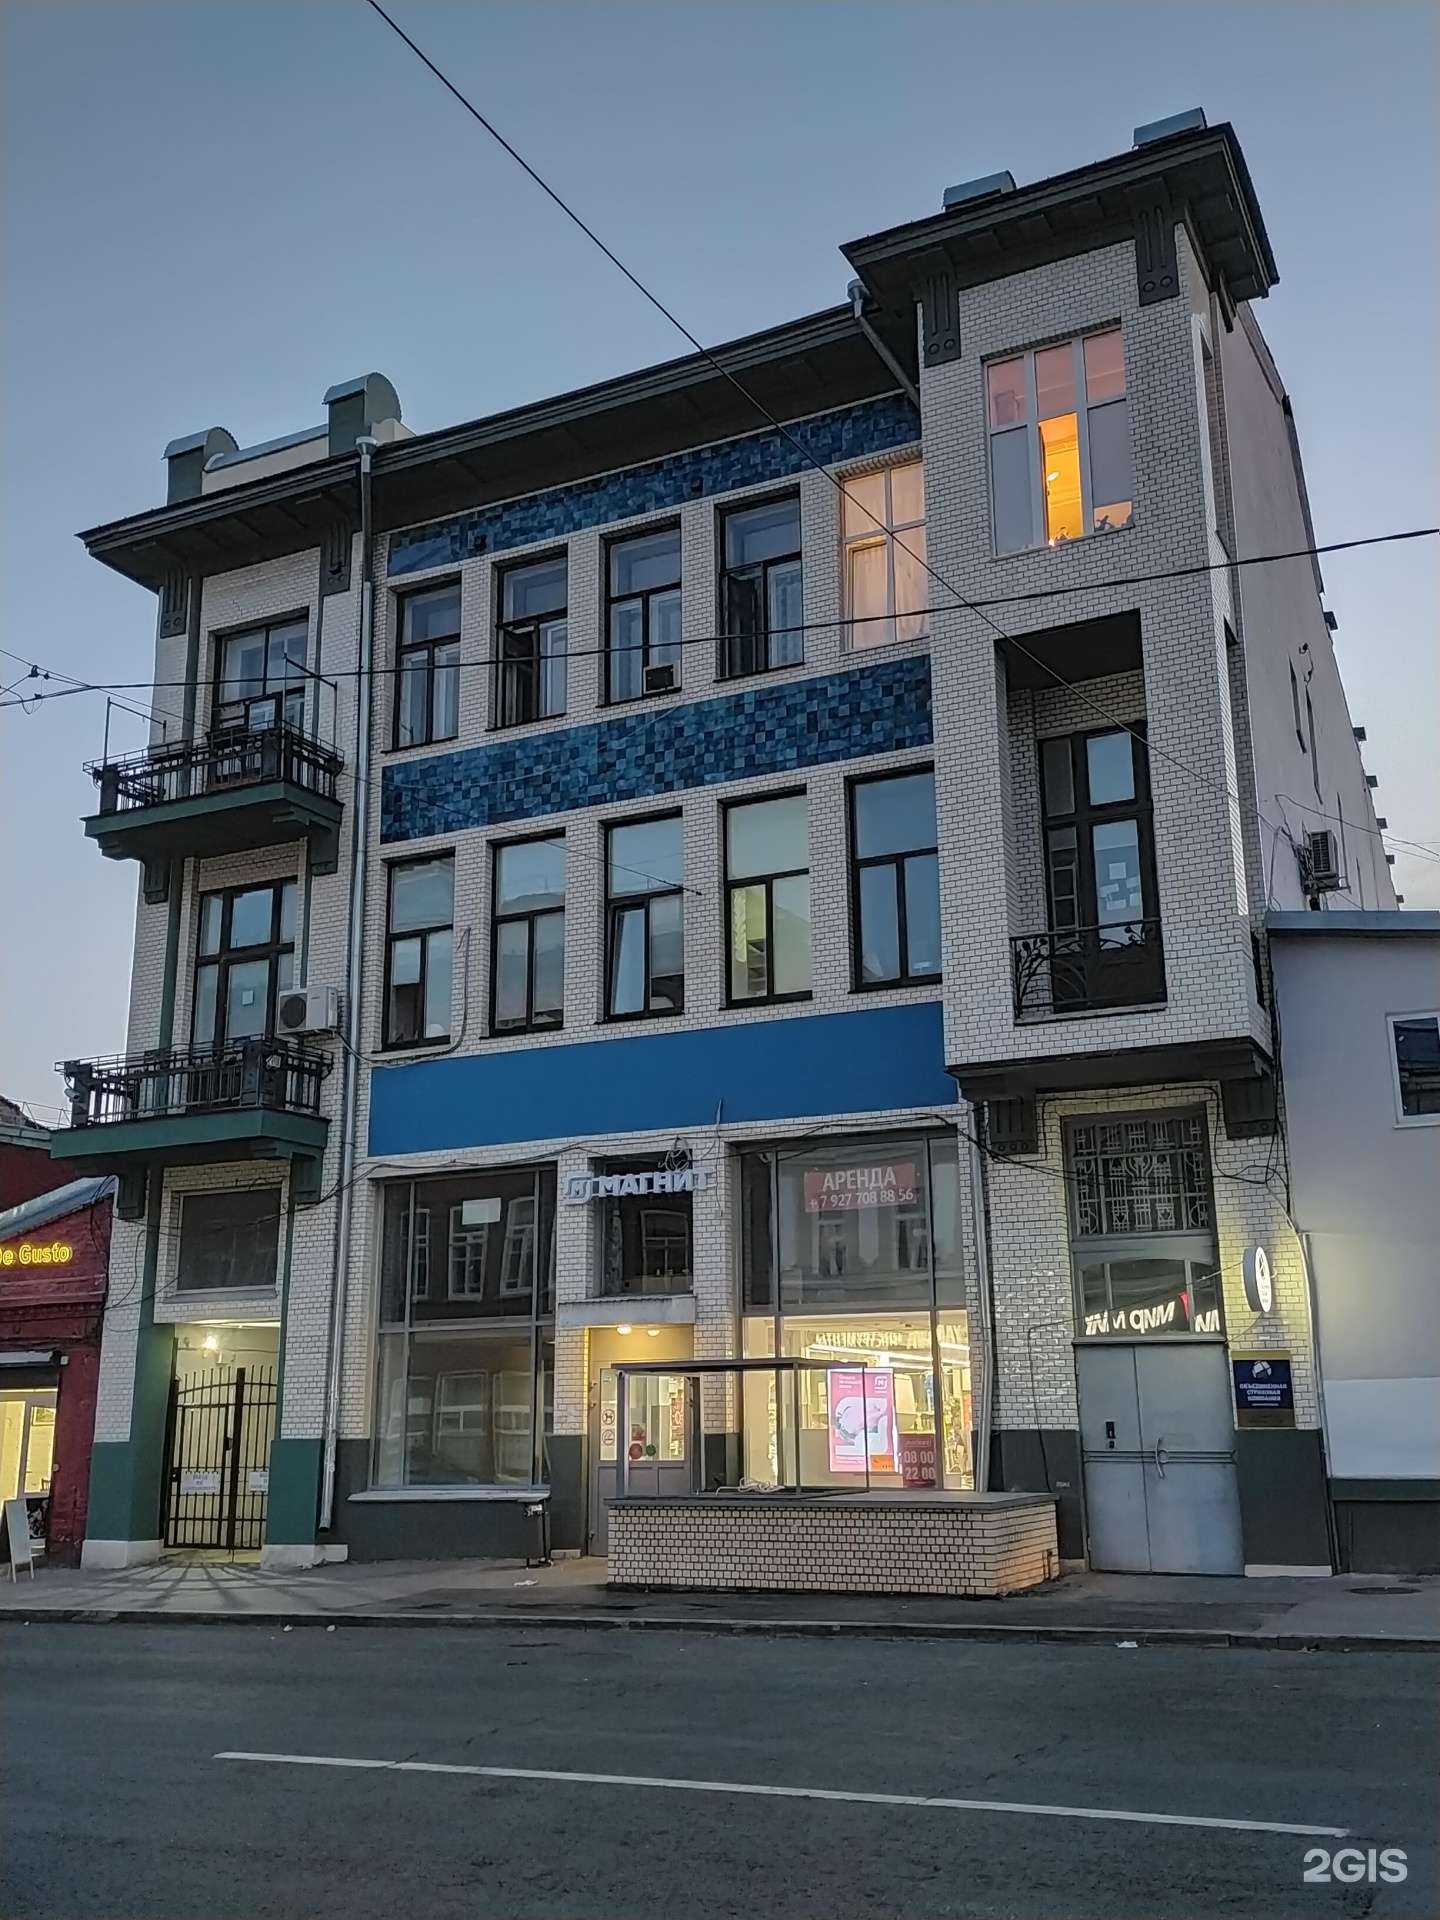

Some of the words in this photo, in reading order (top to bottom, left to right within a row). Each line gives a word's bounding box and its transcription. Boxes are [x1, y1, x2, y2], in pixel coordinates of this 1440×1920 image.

[599, 1166, 717, 1198] МАГНИТ
[822, 1166, 897, 1192] АРЕНДА
[830, 1193, 852, 1208] 927
[855, 1190, 877, 1205] 708
[879, 1189, 896, 1203] 88
[898, 1188, 914, 1202] 56
[0, 1247, 15, 1266] e
[19, 1242, 72, 1265] Gusto
